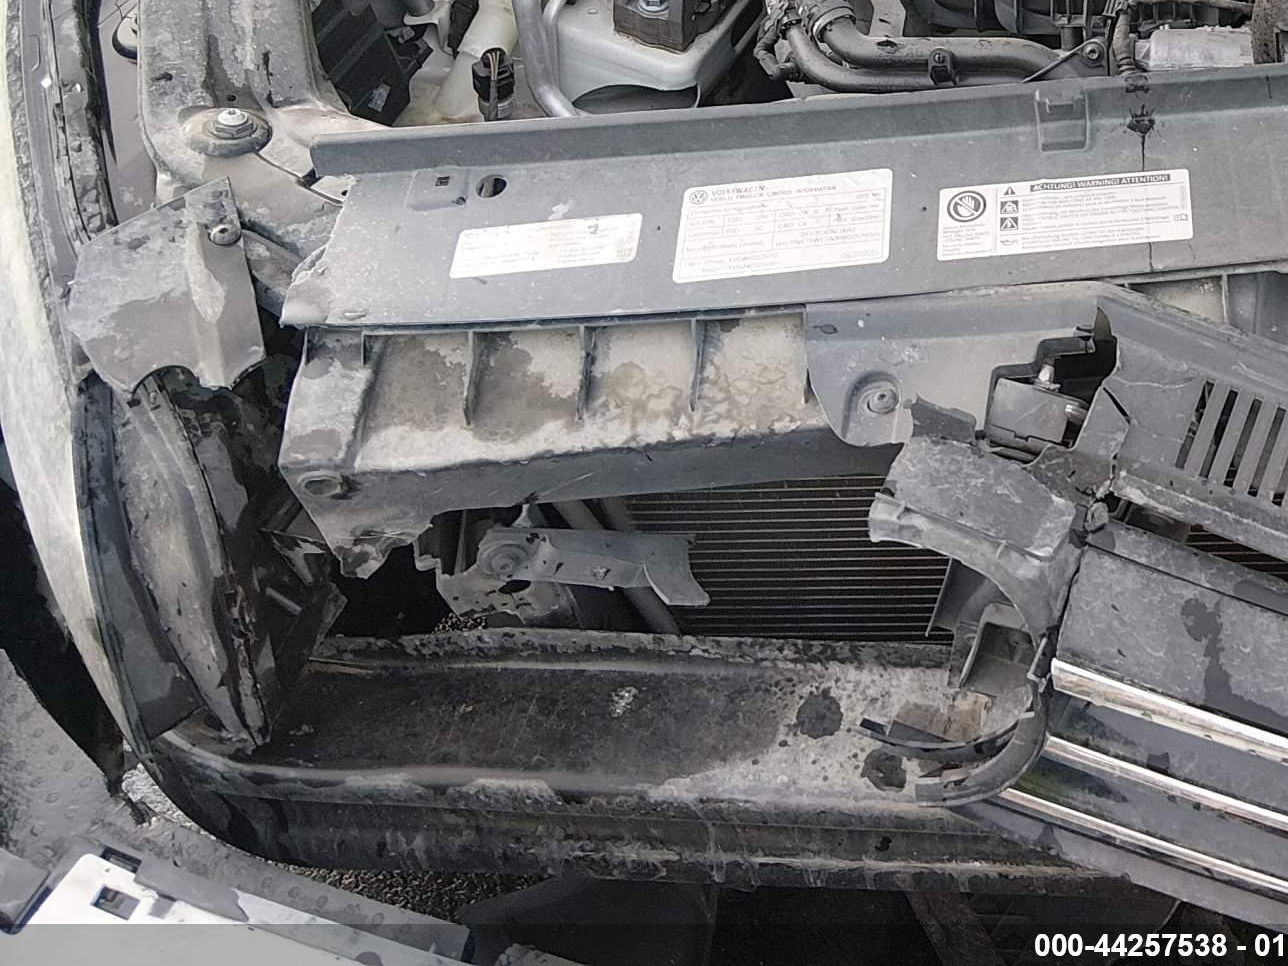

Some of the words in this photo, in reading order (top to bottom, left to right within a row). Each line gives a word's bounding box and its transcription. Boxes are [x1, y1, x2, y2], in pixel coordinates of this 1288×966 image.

[1032, 181, 1076, 191] ACHTUNG!
[1077, 178, 1120, 188] WARNING!
[1120, 173, 1169, 185] ATTENTION!
